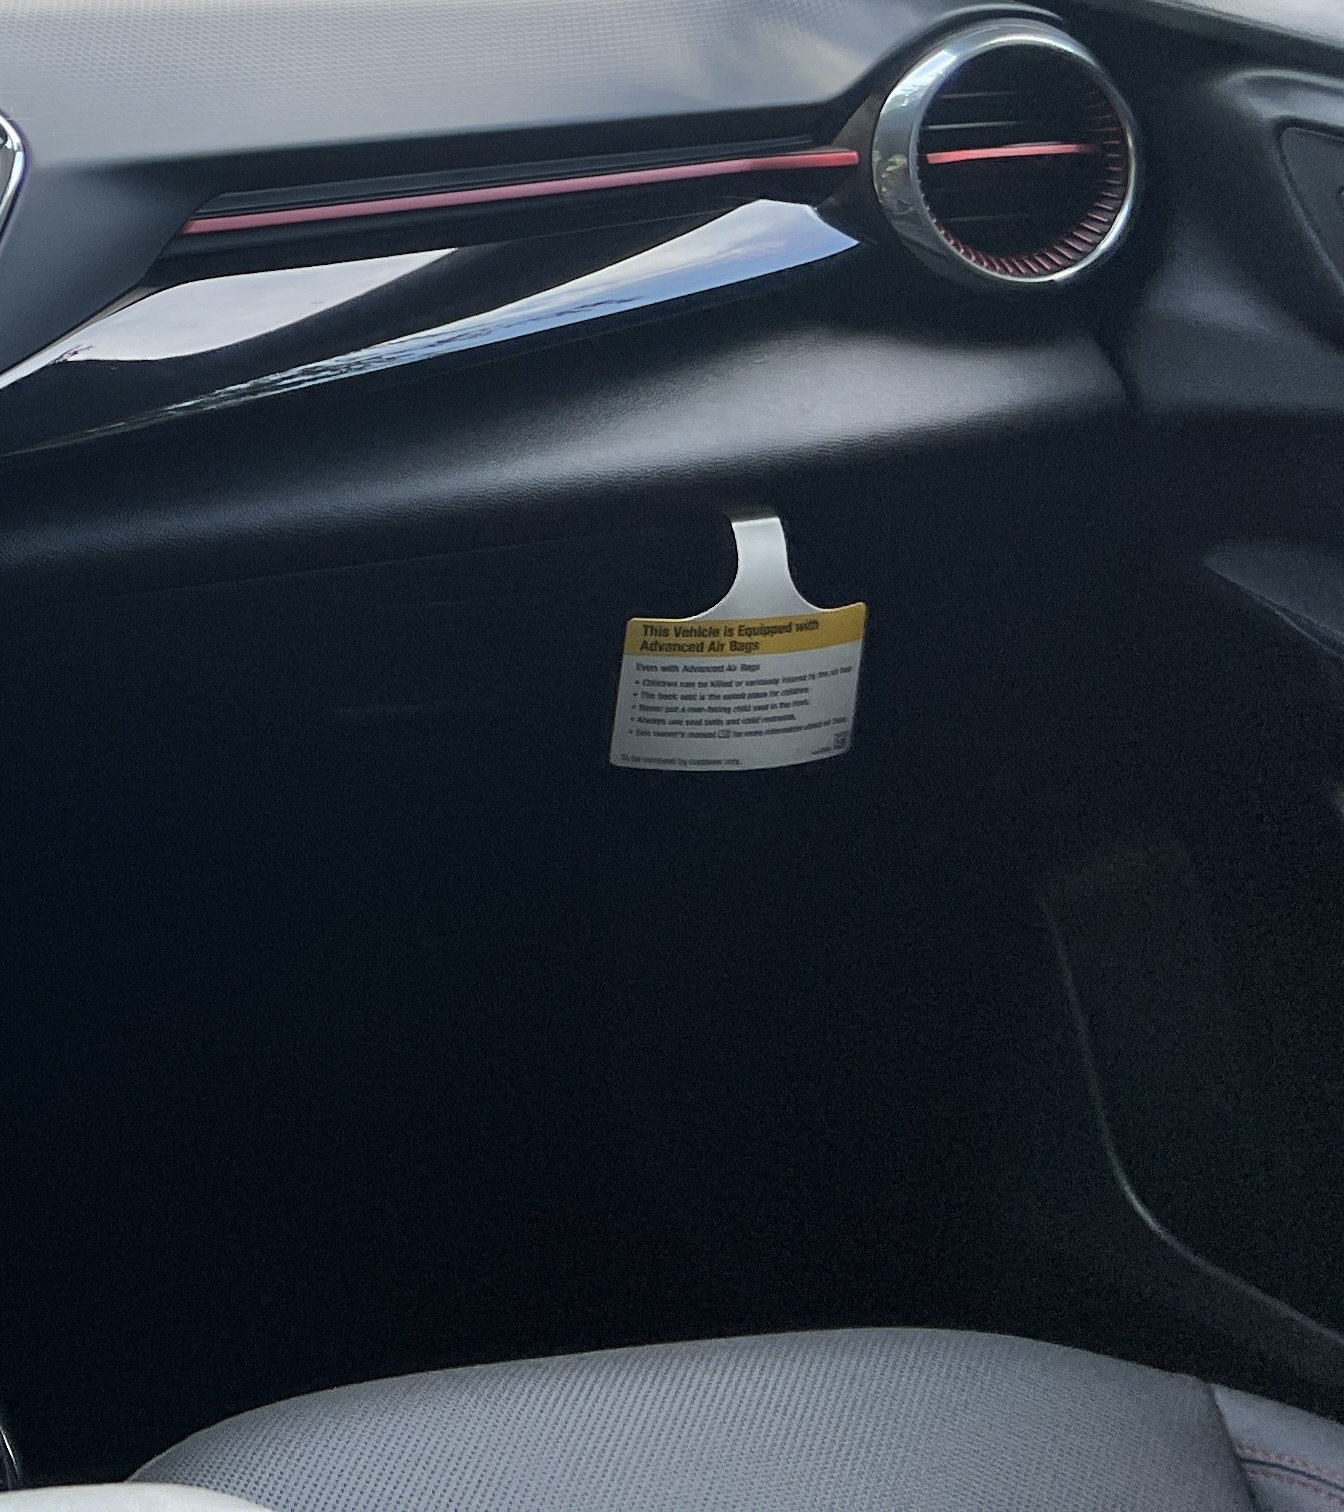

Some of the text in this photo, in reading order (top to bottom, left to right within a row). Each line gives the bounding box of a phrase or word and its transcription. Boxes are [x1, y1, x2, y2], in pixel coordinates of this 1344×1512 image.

[642, 619, 819, 638] This Vehicle is Equipped with
[640, 640, 759, 654] Advanced Air Bags
